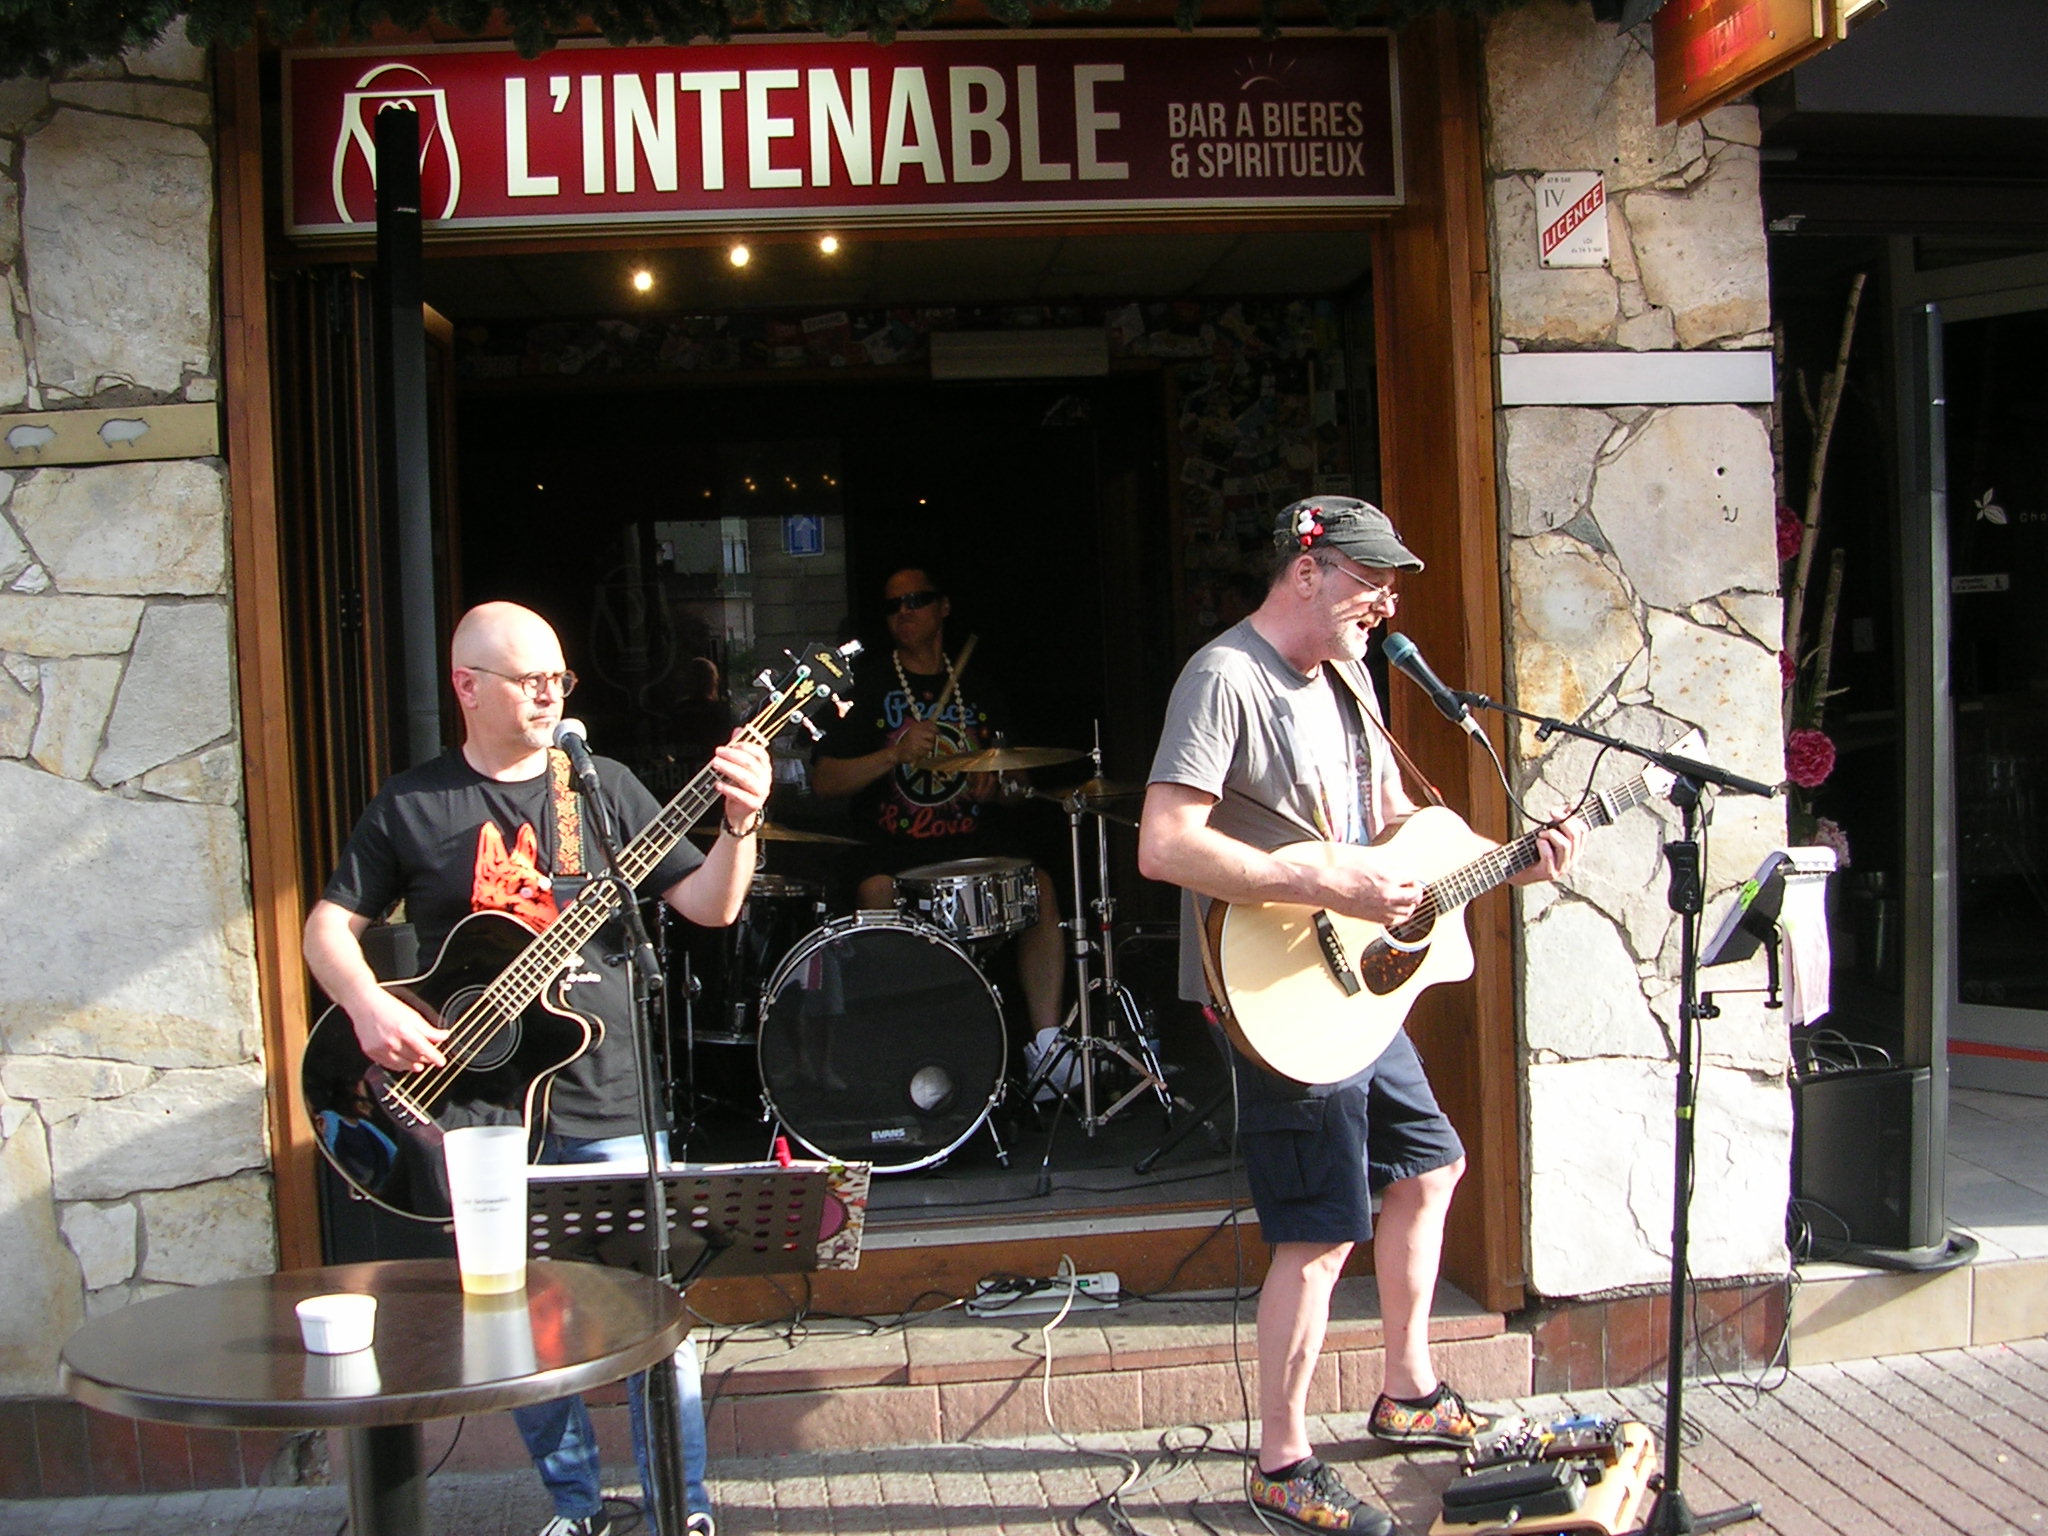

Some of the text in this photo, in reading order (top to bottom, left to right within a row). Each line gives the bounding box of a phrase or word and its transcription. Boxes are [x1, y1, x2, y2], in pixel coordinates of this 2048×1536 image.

[505, 63, 1130, 197] L'INTENABLE
[1167, 101, 1364, 138] BAR A BIERES
[1170, 141, 1366, 179] & SPIRITUEUX
[1544, 189, 1565, 208] IV
[1544, 184, 1602, 253] LICENCE
[908, 807, 976, 839] Love
